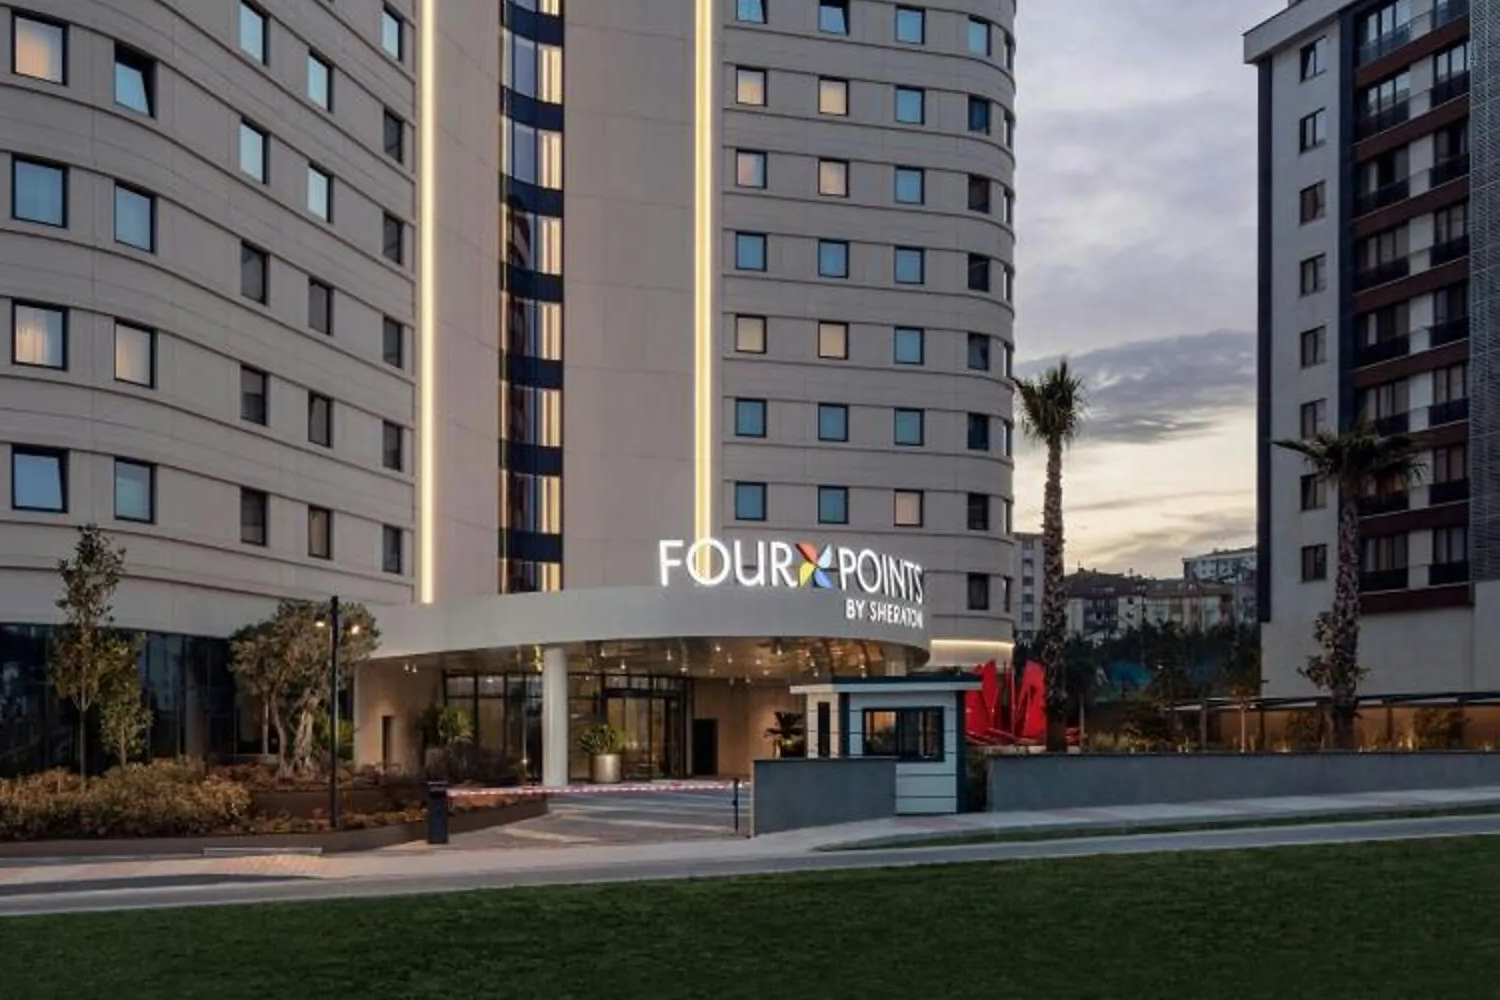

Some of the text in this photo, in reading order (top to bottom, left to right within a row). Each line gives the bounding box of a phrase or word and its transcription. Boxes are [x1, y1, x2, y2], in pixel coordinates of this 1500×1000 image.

[658, 538, 923, 604] FOUR POINTS
[846, 598, 923, 629] BY SHERATON
